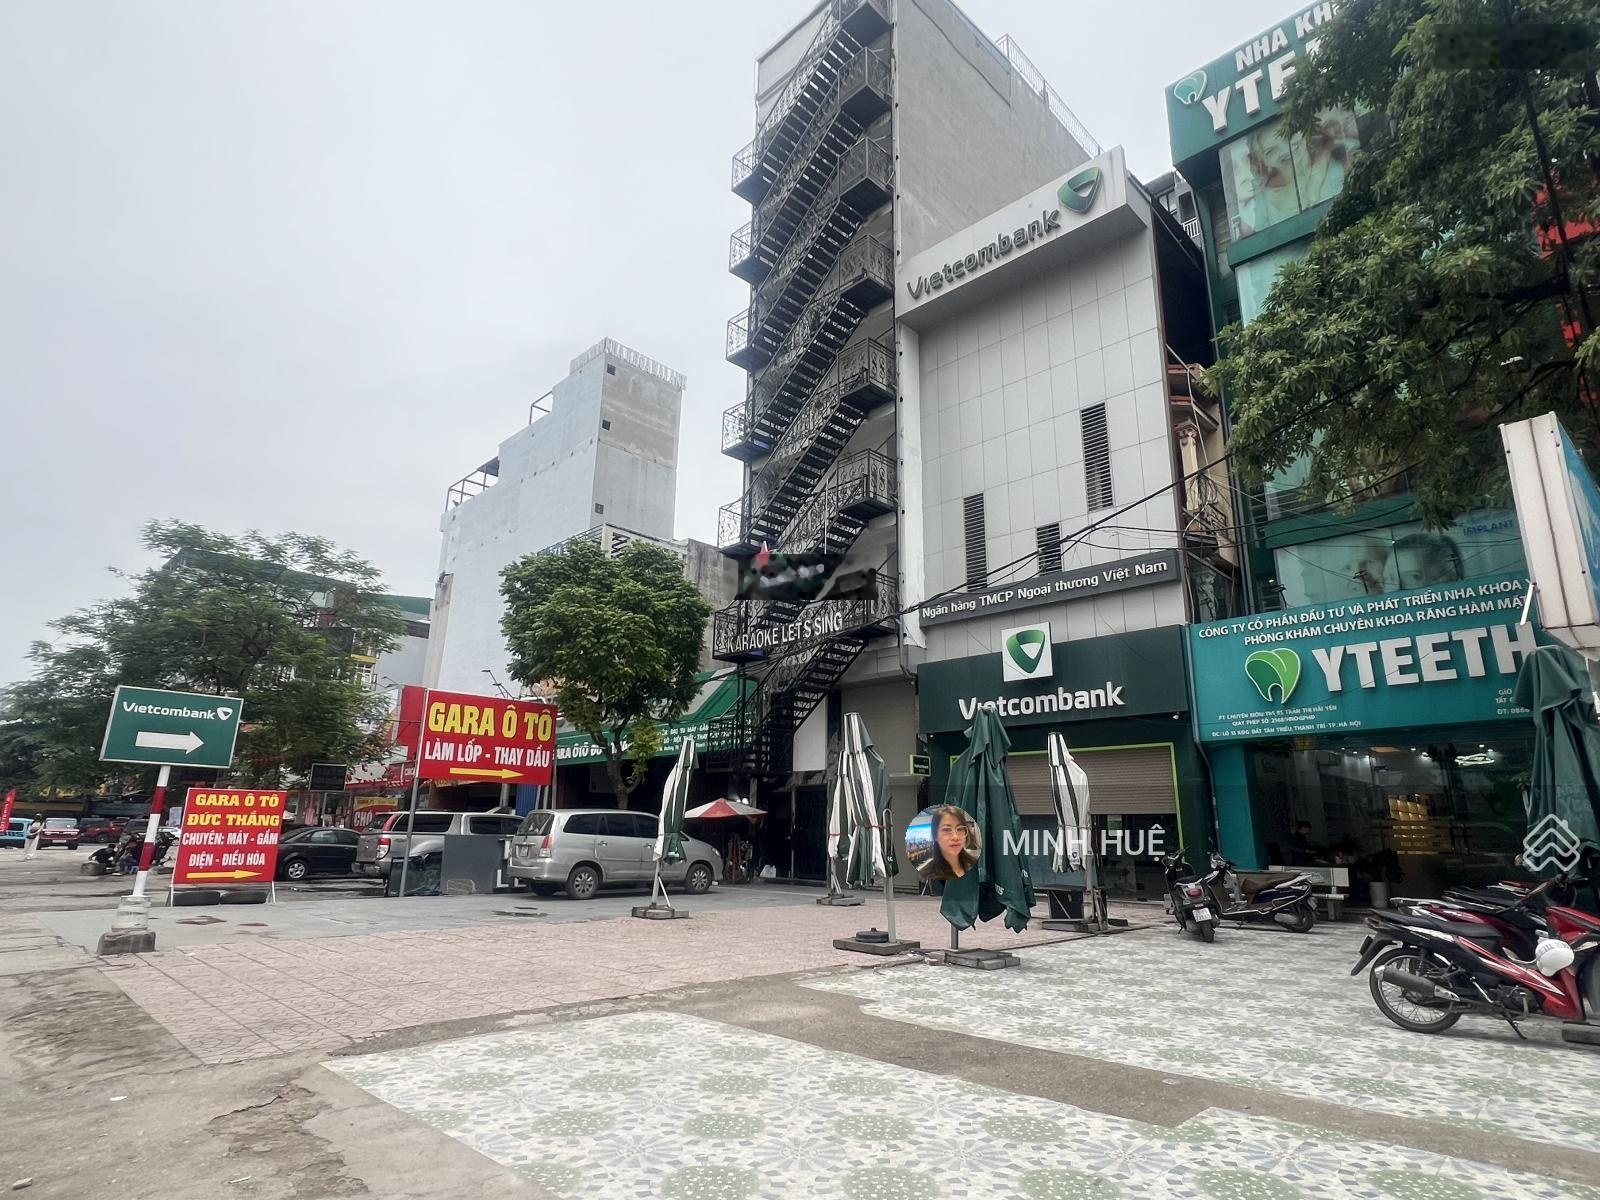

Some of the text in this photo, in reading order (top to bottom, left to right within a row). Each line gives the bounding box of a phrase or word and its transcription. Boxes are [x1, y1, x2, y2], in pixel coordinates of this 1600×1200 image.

[1235, 2, 1338, 72] NHA KH
[907, 208, 1061, 299] Vietcombank
[922, 561, 1168, 619] Ngân hàng TMCP Ngoại thương Việt Nam
[1198, 625, 1229, 639] CÔNG
[1231, 622, 1246, 633] TY
[1247, 616, 1264, 631] CỔ
[1266, 613, 1298, 629] PHẦN
[1300, 609, 1325, 624] ĐẦU
[1327, 607, 1346, 618] TƯ
[1348, 602, 1365, 616] VÀ
[1367, 598, 1400, 613] PHÁT
[1403, 589, 1442, 607] TRIỂN
[1443, 587, 1476, 602] NHA
[1478, 579, 1522, 596] KHOA
[727, 627, 779, 652] KARAOKE
[814, 611, 843, 636] SING
[1244, 630, 1284, 646] PHÒNG
[1285, 624, 1321, 641] KHÁM
[1323, 617, 1374, 634] CHUYÊN
[1376, 614, 1414, 629] KHOA
[1416, 606, 1457, 622] RĂNG
[1459, 600, 1495, 616] HÀM
[1312, 621, 1537, 693] YTEETH
[123, 701, 216, 720] Vietcombank
[428, 701, 553, 742] GARA Ô TÔ
[424, 738, 455, 761] LÀM
[457, 738, 483, 763] LỐP
[494, 746, 524, 766] THAY
[525, 744, 551, 768] DẦU
[552, 747, 572, 760] ARA
[187, 810, 280, 827] ĐỨC THẮNG
[195, 792, 279, 808] GARA Ô TÔ
[182, 830, 225, 845] CHUYÊN:
[226, 830, 249, 845] MÁY
[188, 850, 213, 869] ĐIỆN
